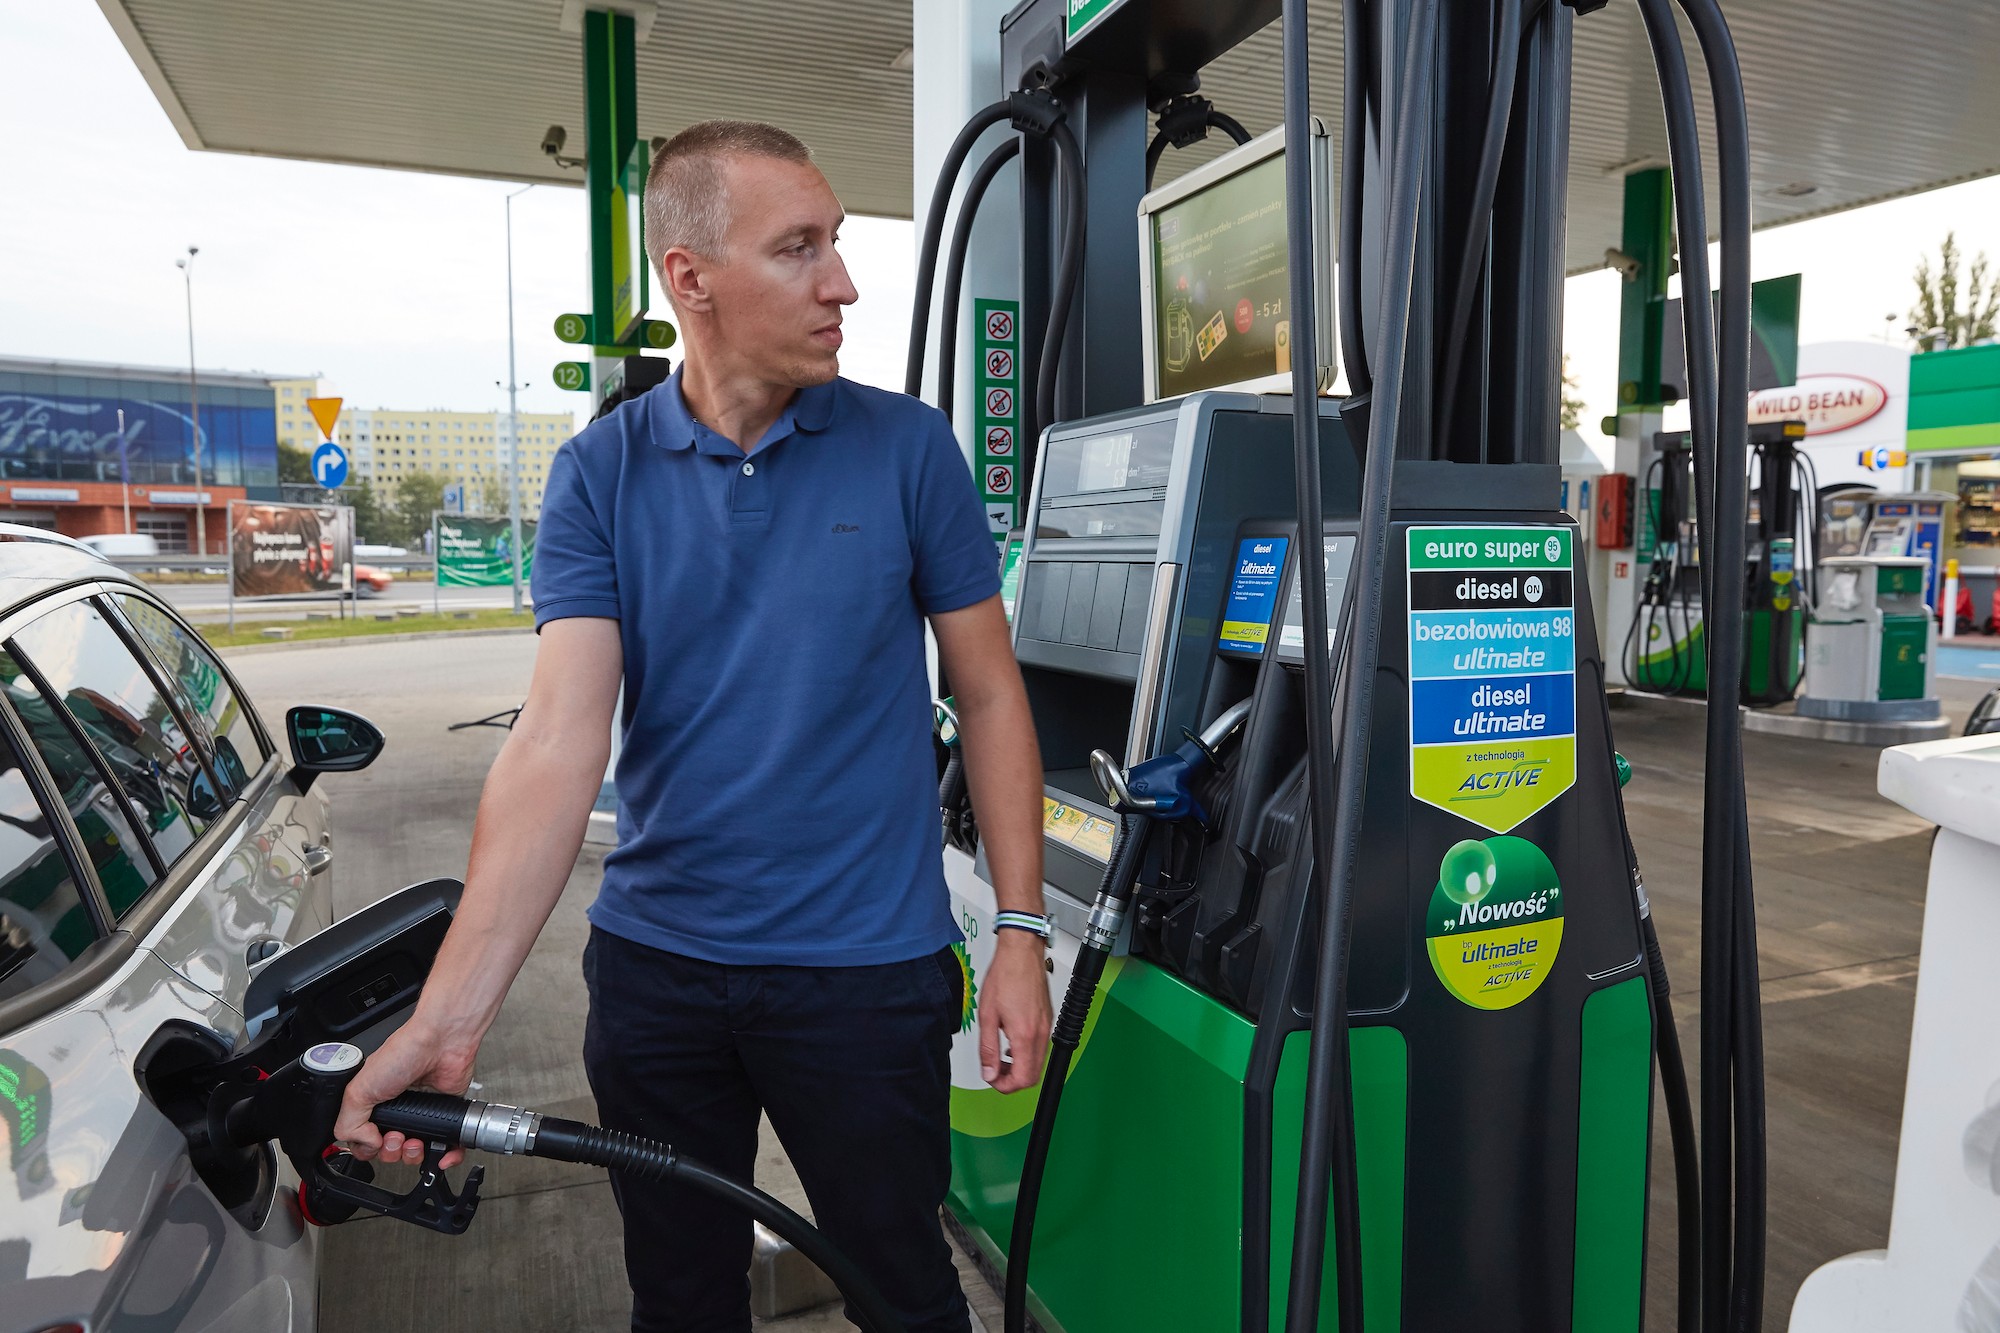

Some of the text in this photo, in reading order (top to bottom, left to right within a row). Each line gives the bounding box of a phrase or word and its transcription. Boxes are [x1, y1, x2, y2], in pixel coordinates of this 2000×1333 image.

[1259, 200, 1283, 218] punkty
[1263, 302, 1270, 317] 5
[1272, 298, 1282, 315] zł
[563, 320, 576, 337] 8
[656, 326, 668, 343] 7
[556, 367, 578, 385] 12
[1756, 389, 1864, 415] WILD BEAN
[1253, 543, 1272, 554] diesel
[1425, 540, 1558, 563] euro super 95
[1240, 562, 1277, 575] ultimate
[1455, 577, 1540, 600] diesel ON
[1415, 616, 1571, 641] bezołowiowa 98
[1453, 645, 1545, 671] ultimate
[1471, 683, 1531, 708] diesel
[1453, 708, 1546, 735] ultimate
[1466, 749, 1525, 762] z technologią
[1457, 768, 1543, 792] ACTIVE
[1055, 807, 1065, 820] 3
[962, 904, 978, 943] bp
[1461, 937, 1538, 964] ultimate
[1462, 940, 1473, 950] bp
[1483, 968, 1533, 988] ACTIVE
